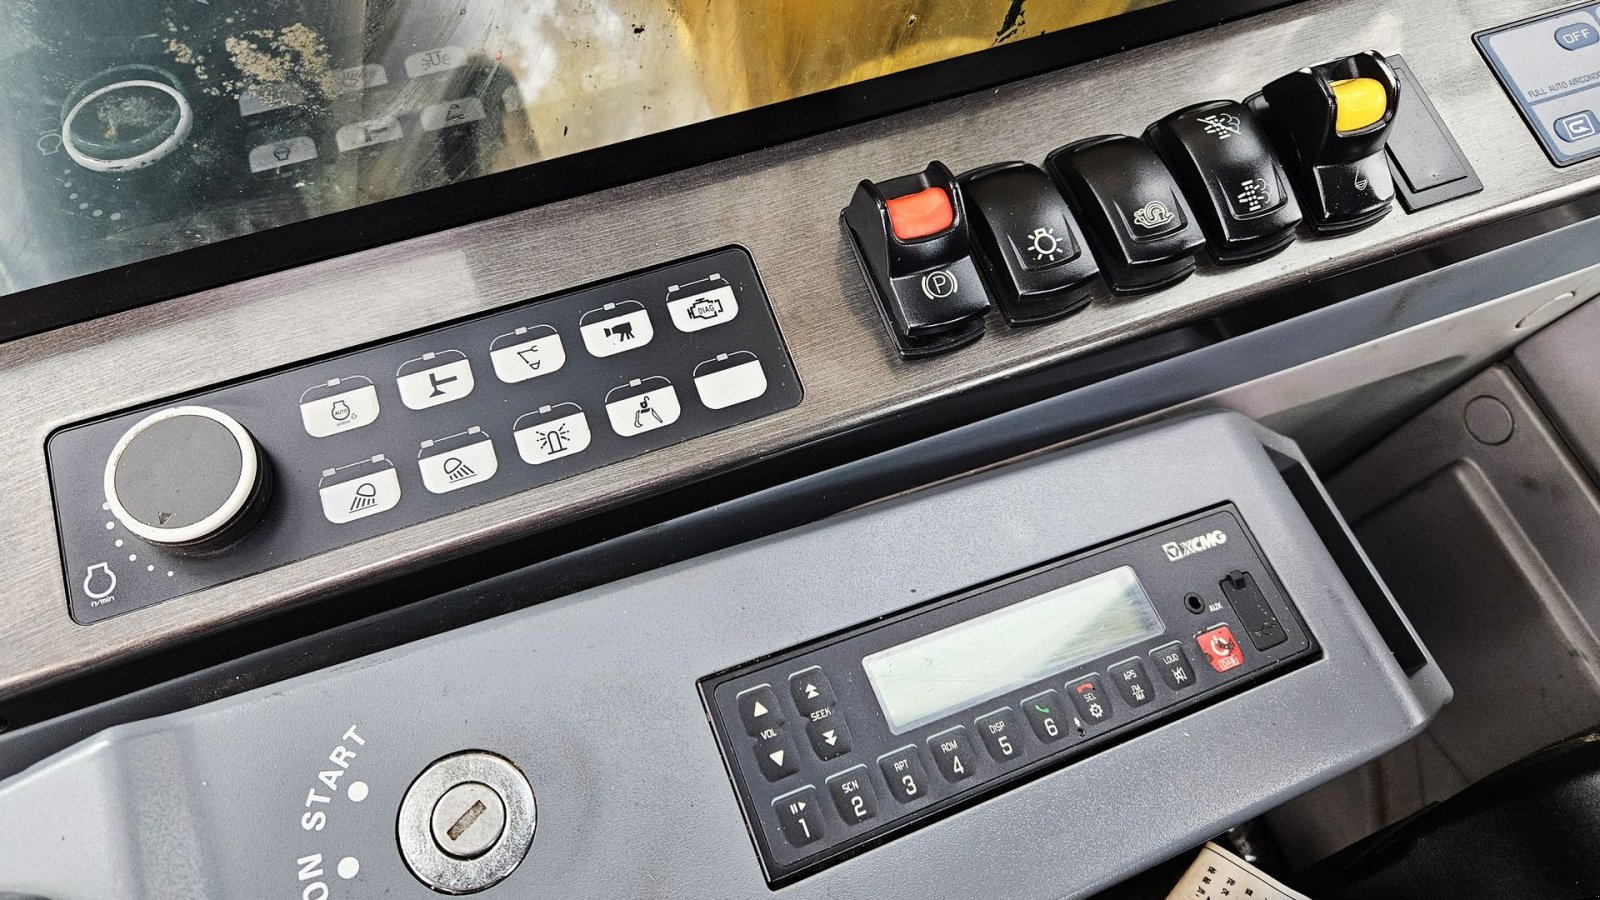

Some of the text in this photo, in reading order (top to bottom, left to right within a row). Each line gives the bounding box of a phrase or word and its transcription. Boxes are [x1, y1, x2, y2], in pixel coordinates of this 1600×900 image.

[1562, 28, 1591, 44] OFF
[1527, 88, 1548, 98] FULL
[1548, 81, 1568, 93] AUTO
[697, 303, 715, 315] DIAG
[1179, 530, 1227, 556] XCMG
[91, 596, 115, 607] n/min
[1209, 602, 1223, 612] AUX
[1163, 653, 1179, 665] LOUD
[1123, 669, 1137, 681] APS
[1083, 692, 1096, 702] SEL
[810, 708, 832, 722] SEEK
[760, 729, 777, 739] VOL
[989, 721, 1005, 734] DISP
[1044, 717, 1059, 737] 6
[941, 740, 958, 754] RDM
[998, 735, 1013, 755] 5
[894, 758, 909, 772] RPT
[953, 756, 965, 775] 4
[301, 724, 366, 832] START
[841, 780, 859, 794] SCN
[902, 775, 916, 796] 3
[851, 796, 867, 817] 2
[798, 817, 810, 838] 1
[297, 853, 329, 900] ON
